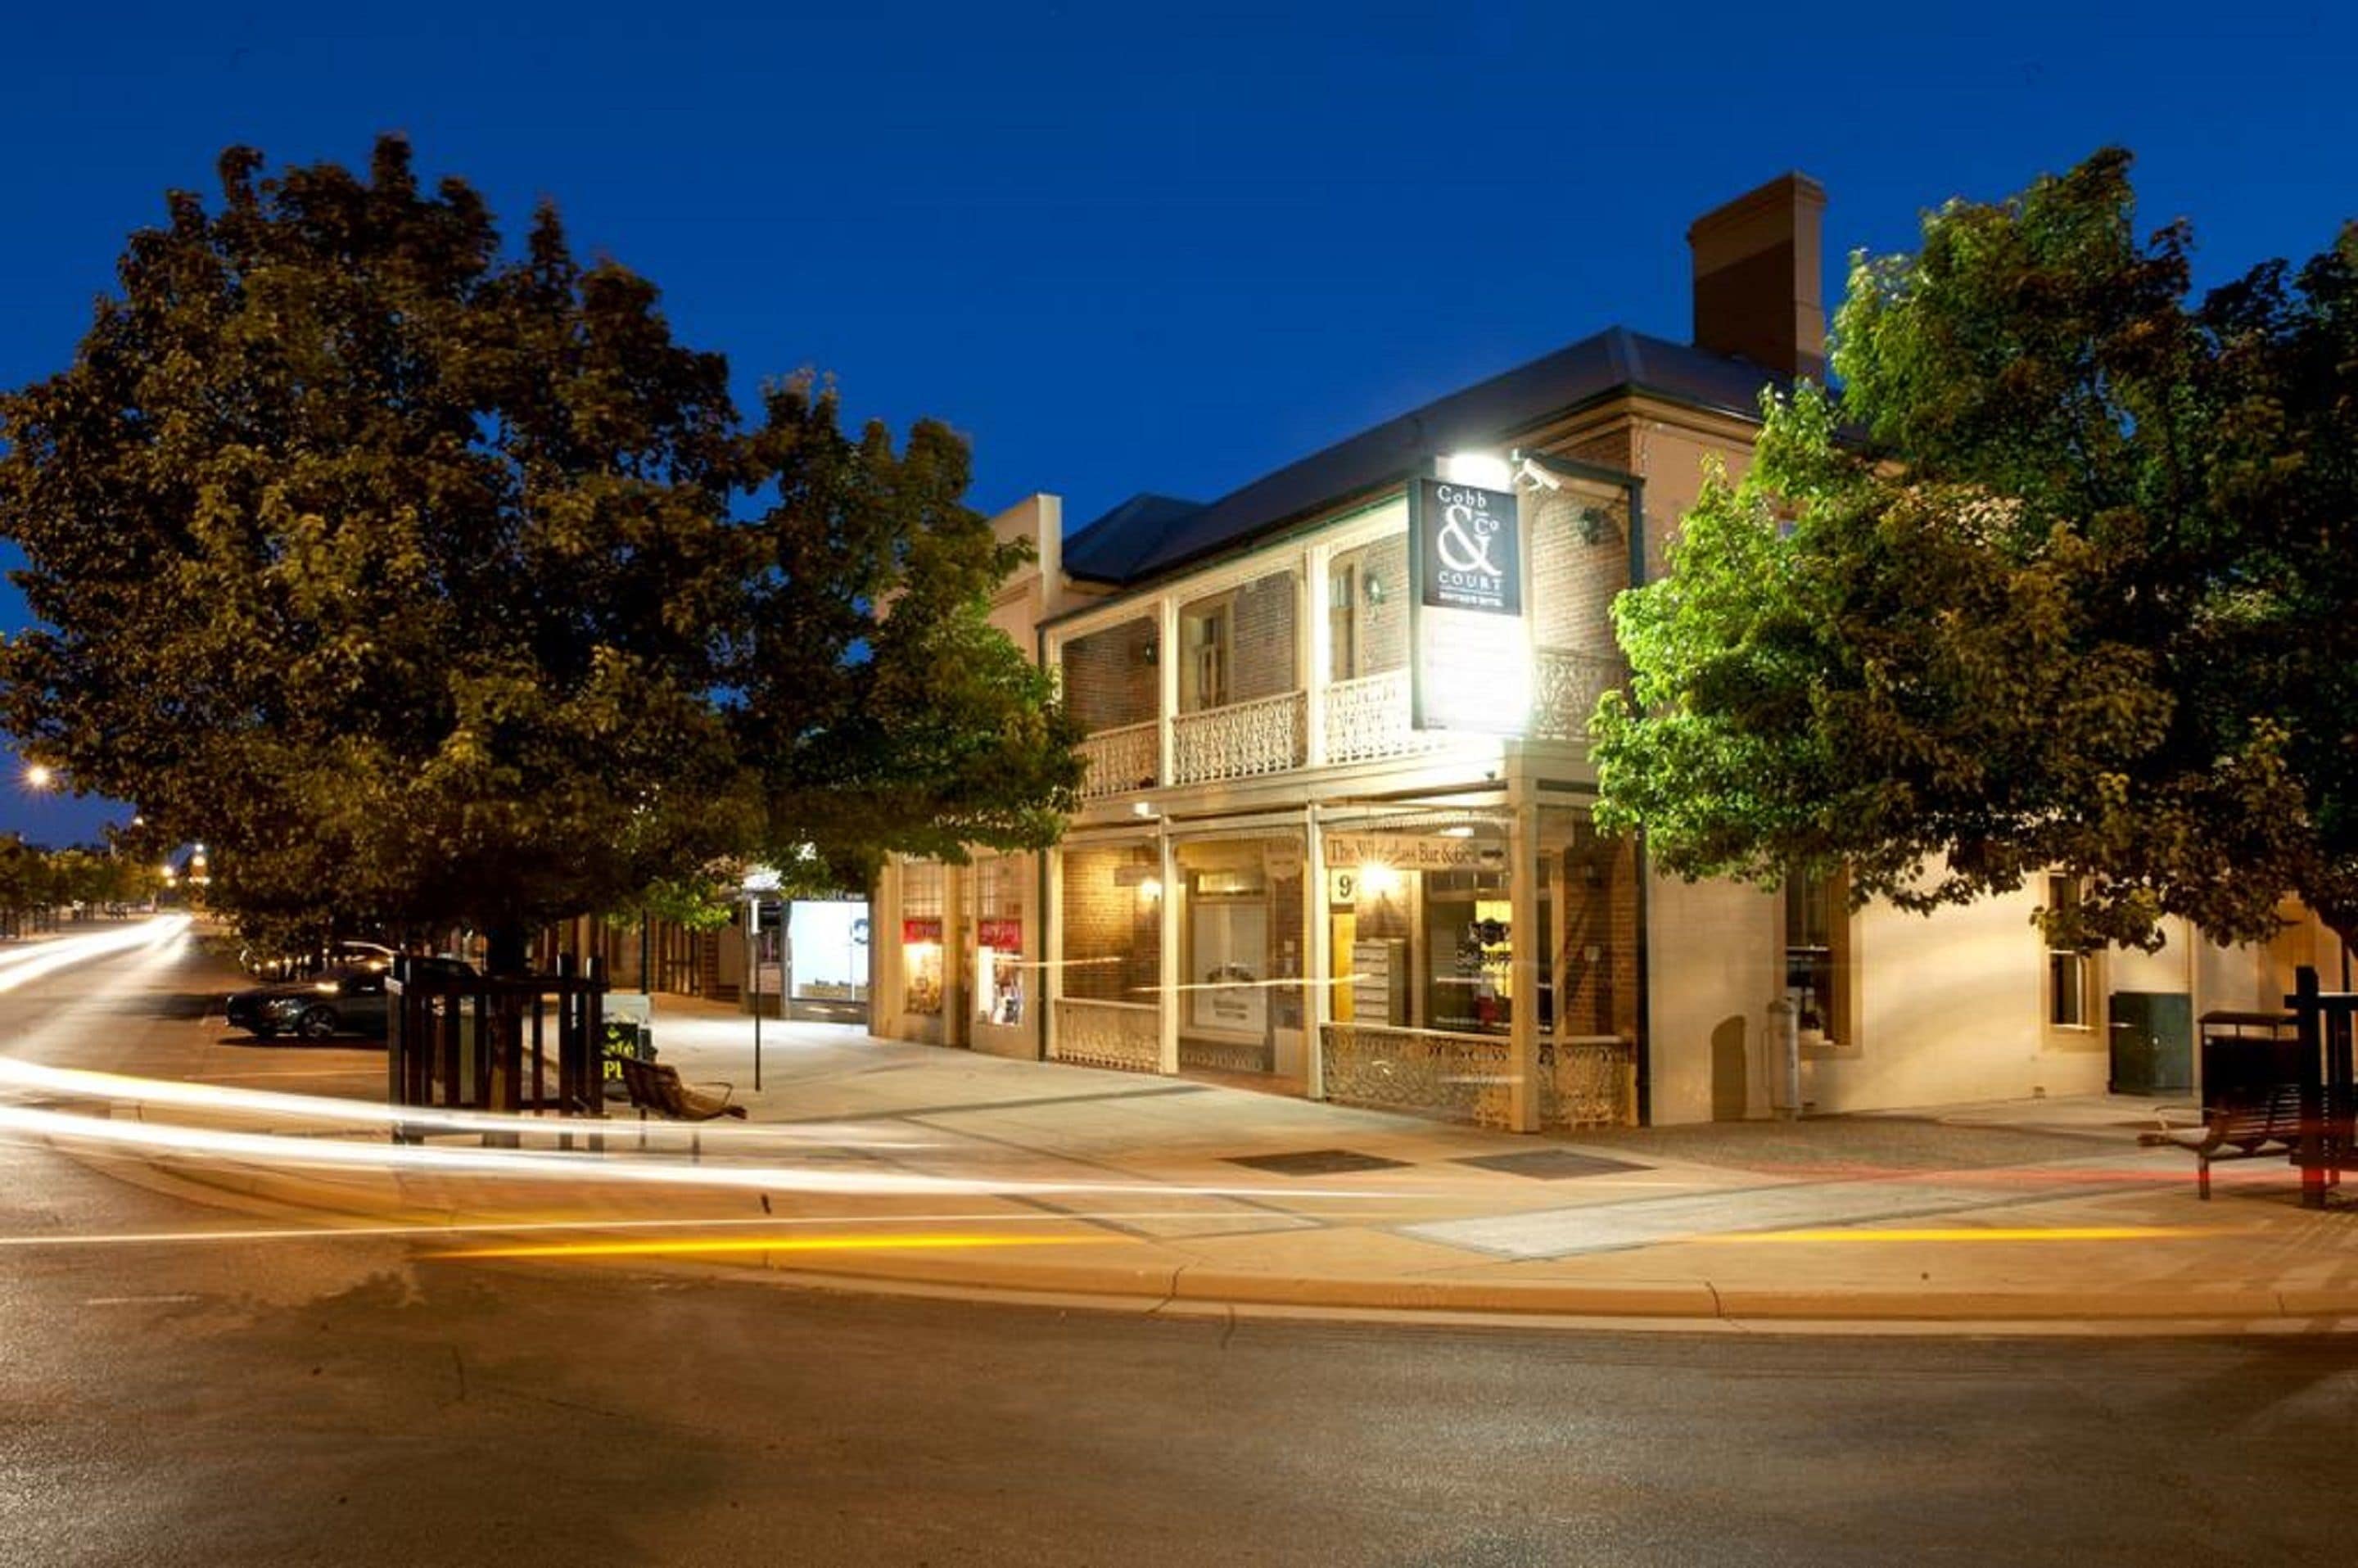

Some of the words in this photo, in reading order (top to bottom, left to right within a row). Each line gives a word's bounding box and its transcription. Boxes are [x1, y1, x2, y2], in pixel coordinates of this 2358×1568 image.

[1438, 486, 1487, 508] Cobb
[1438, 504, 1503, 576] &
[1439, 571, 1503, 590] COURT
[1329, 838, 1355, 861] The
[1339, 874, 1351, 898] 9
